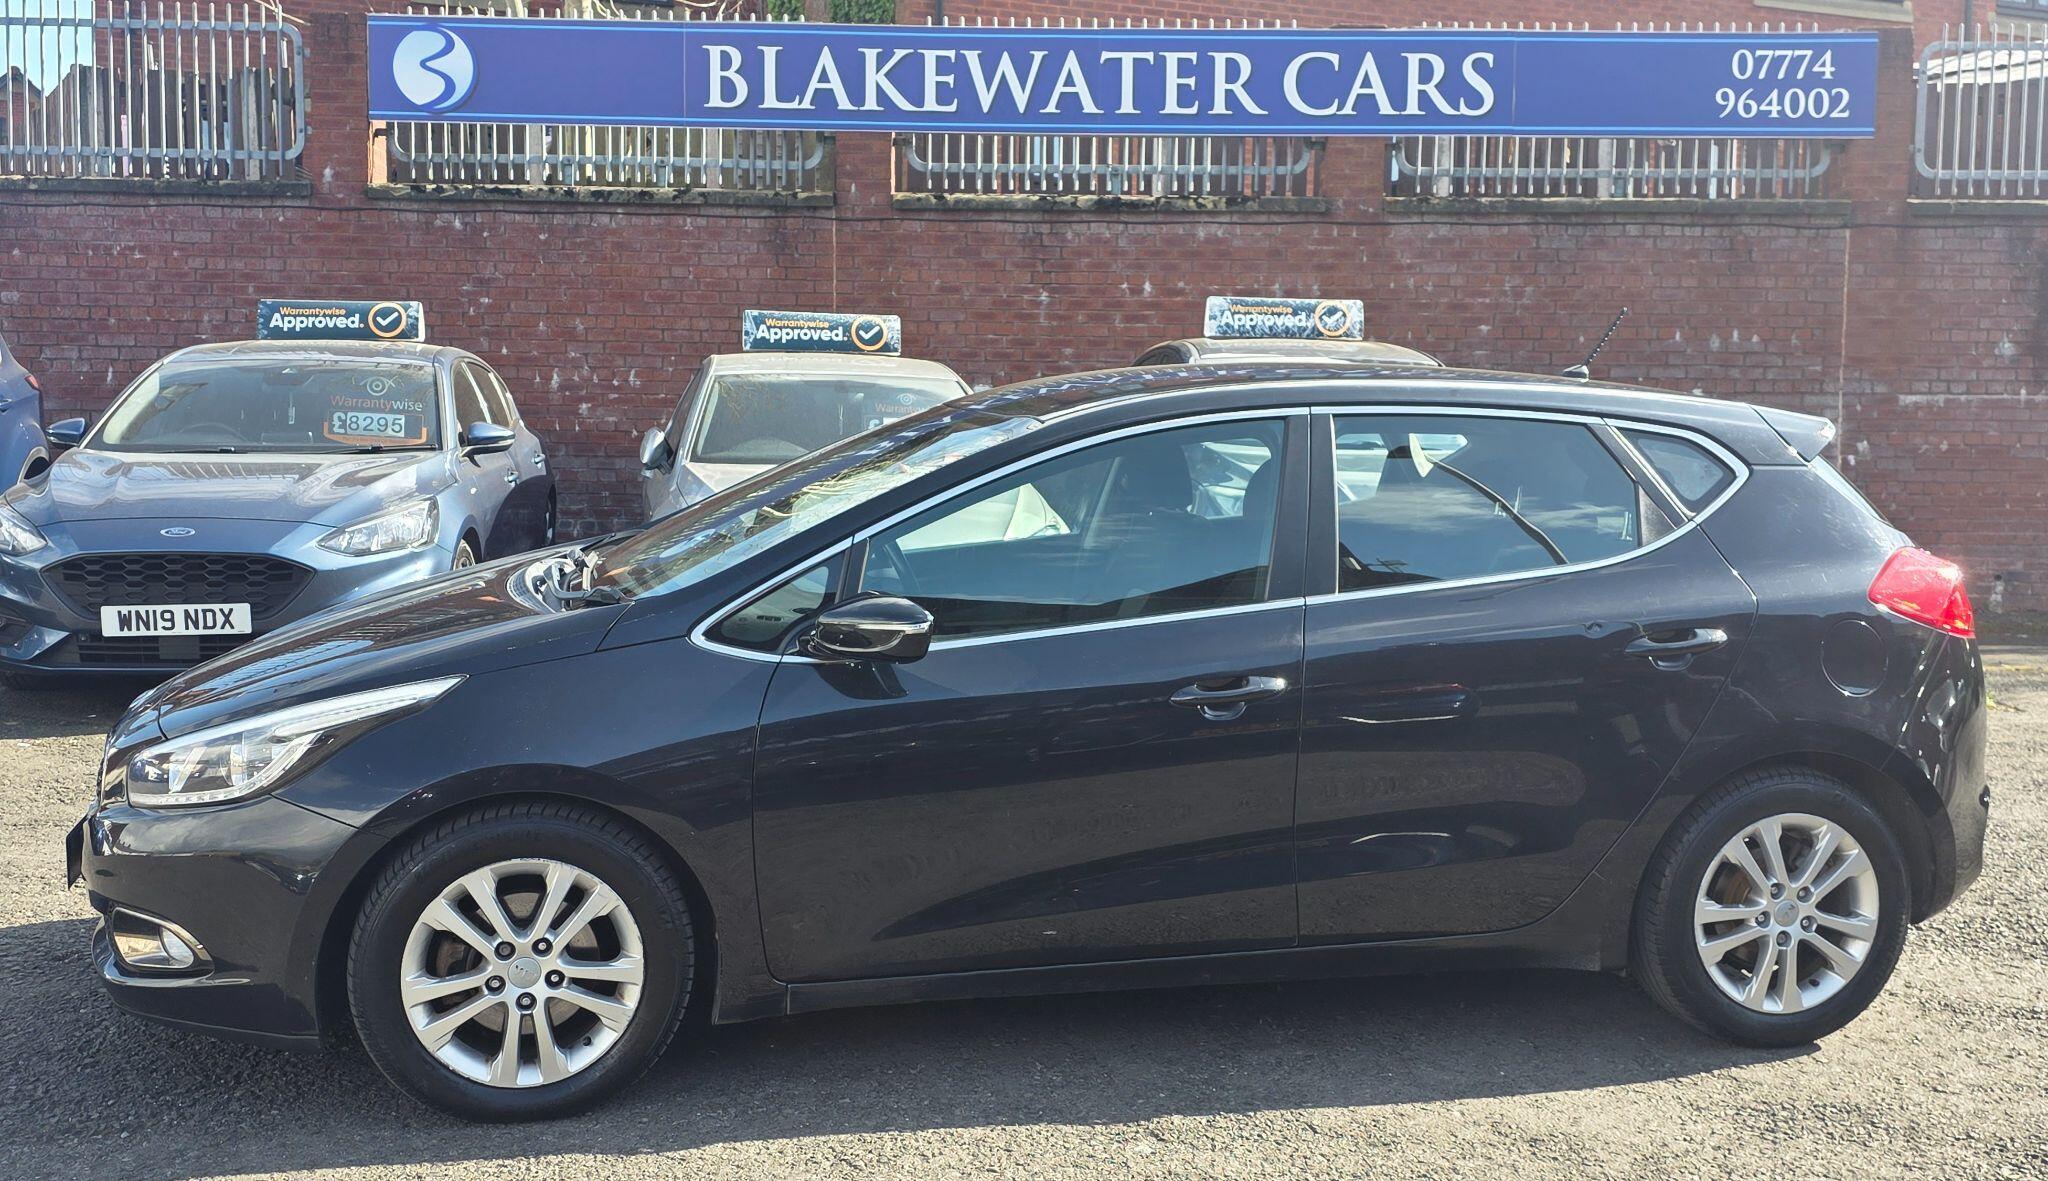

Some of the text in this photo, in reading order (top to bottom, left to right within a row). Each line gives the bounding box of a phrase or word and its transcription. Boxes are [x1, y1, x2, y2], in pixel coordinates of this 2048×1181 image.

[1731, 49, 1836, 80] 07774
[702, 44, 1495, 116] BLAKEWATER CARS
[1715, 87, 1850, 119] 964002
[279, 306, 346, 316] Warrantywise
[269, 313, 364, 332] Approved.
[765, 318, 830, 328] Warrantywise
[756, 324, 848, 343] Approved.
[330, 395, 423, 412] Warrantywise
[332, 411, 403, 434] £8295
[117, 608, 235, 632] WN19 NDX
